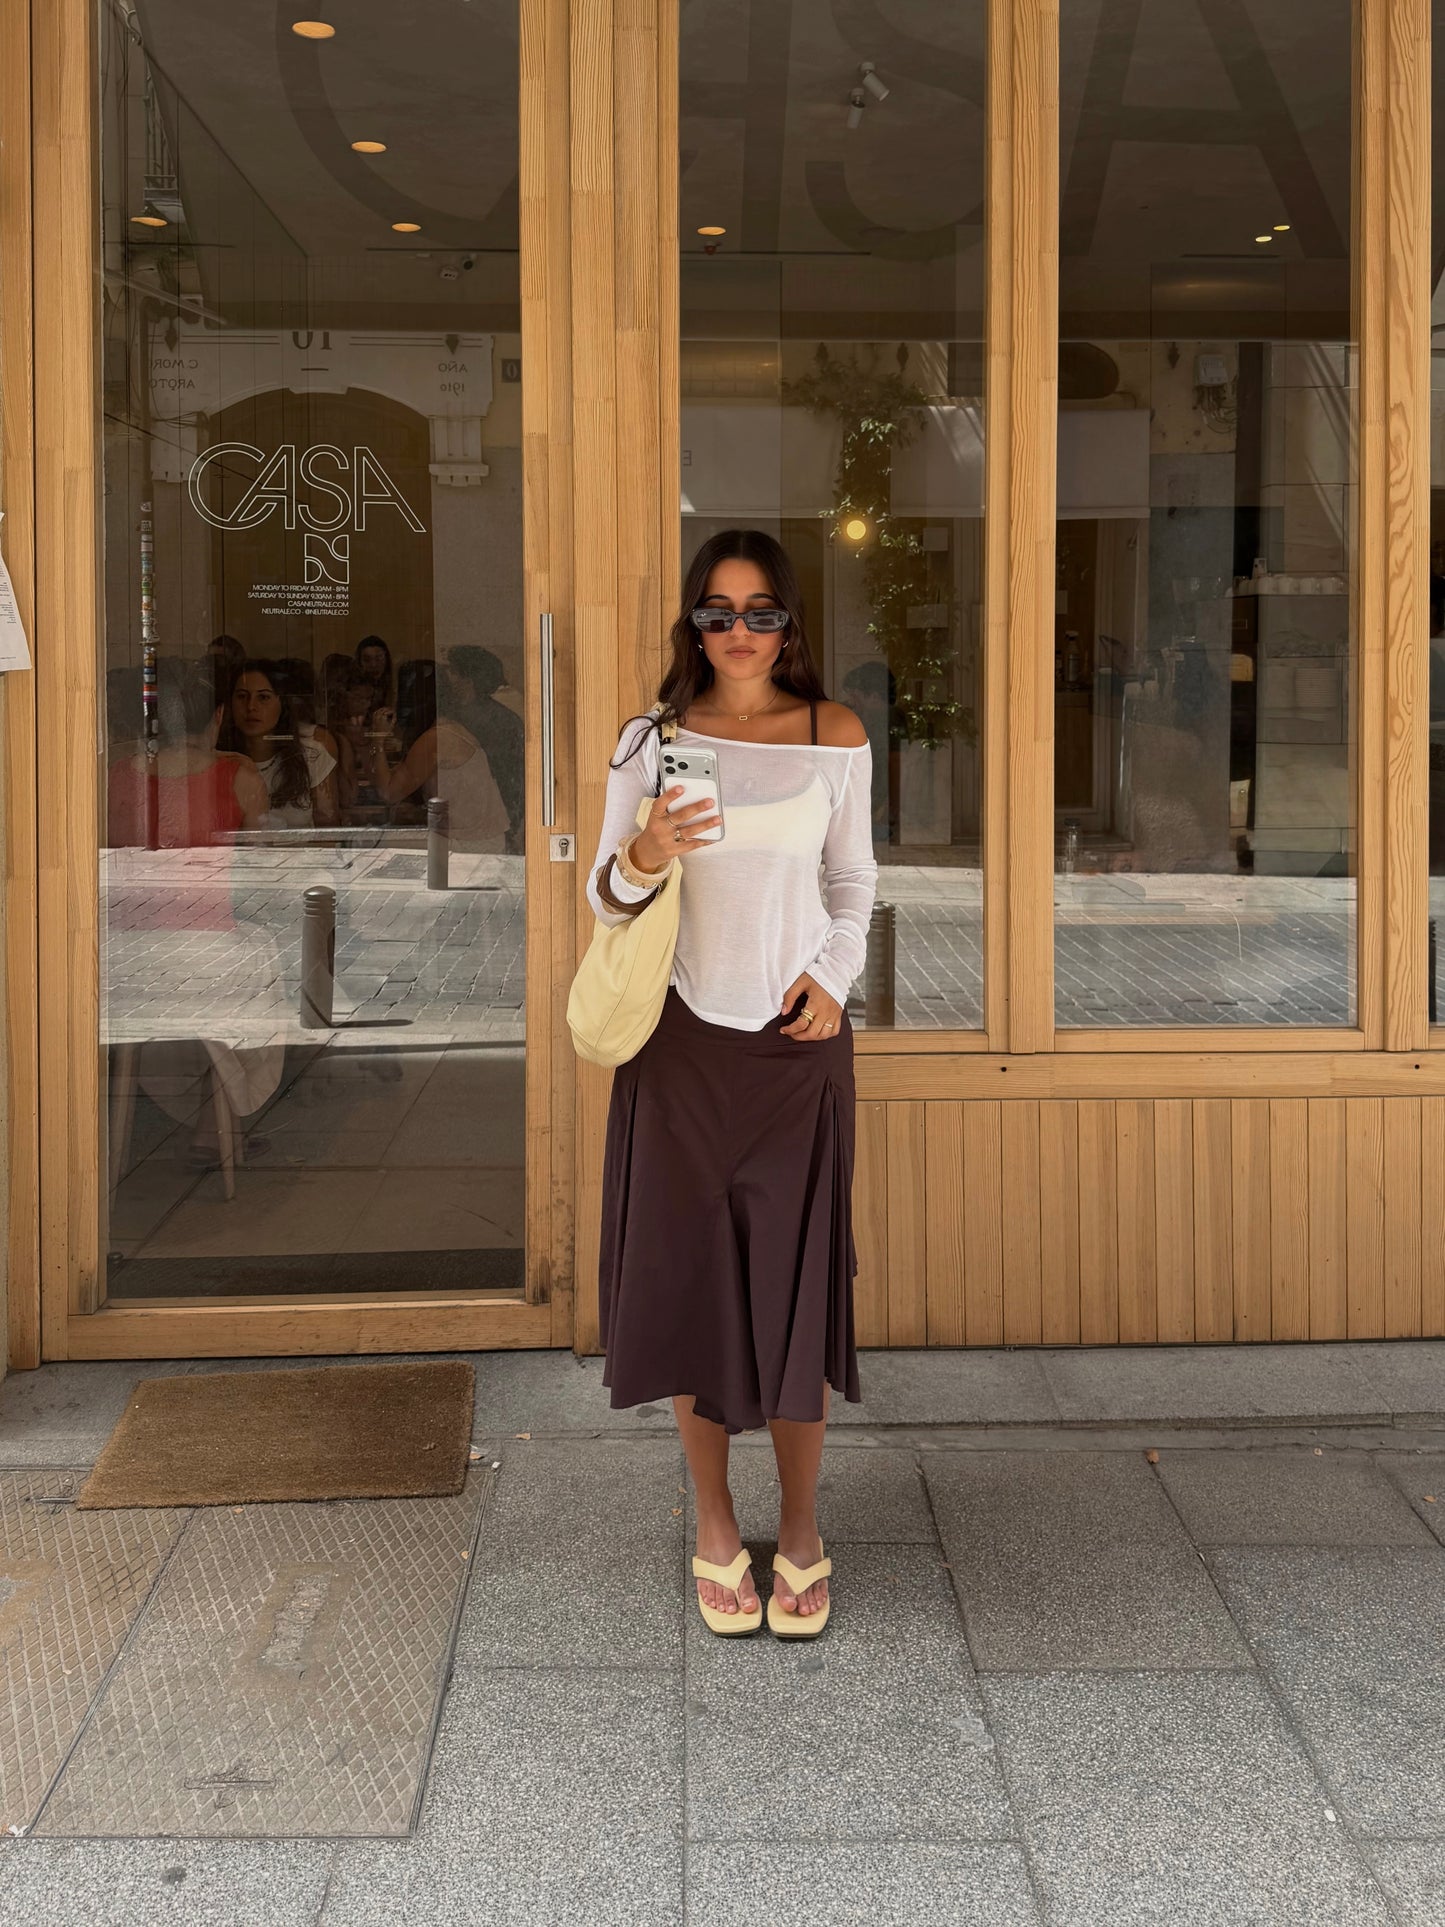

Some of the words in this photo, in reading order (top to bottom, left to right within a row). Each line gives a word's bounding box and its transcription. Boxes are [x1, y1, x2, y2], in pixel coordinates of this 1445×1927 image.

[188, 442, 427, 533] CASA
[287, 600, 349, 608] CASANEUTRALE.COM
[261, 608, 301, 616] NEUTRALE.CO
[305, 608, 349, 616] @NEUTRALE.CO
